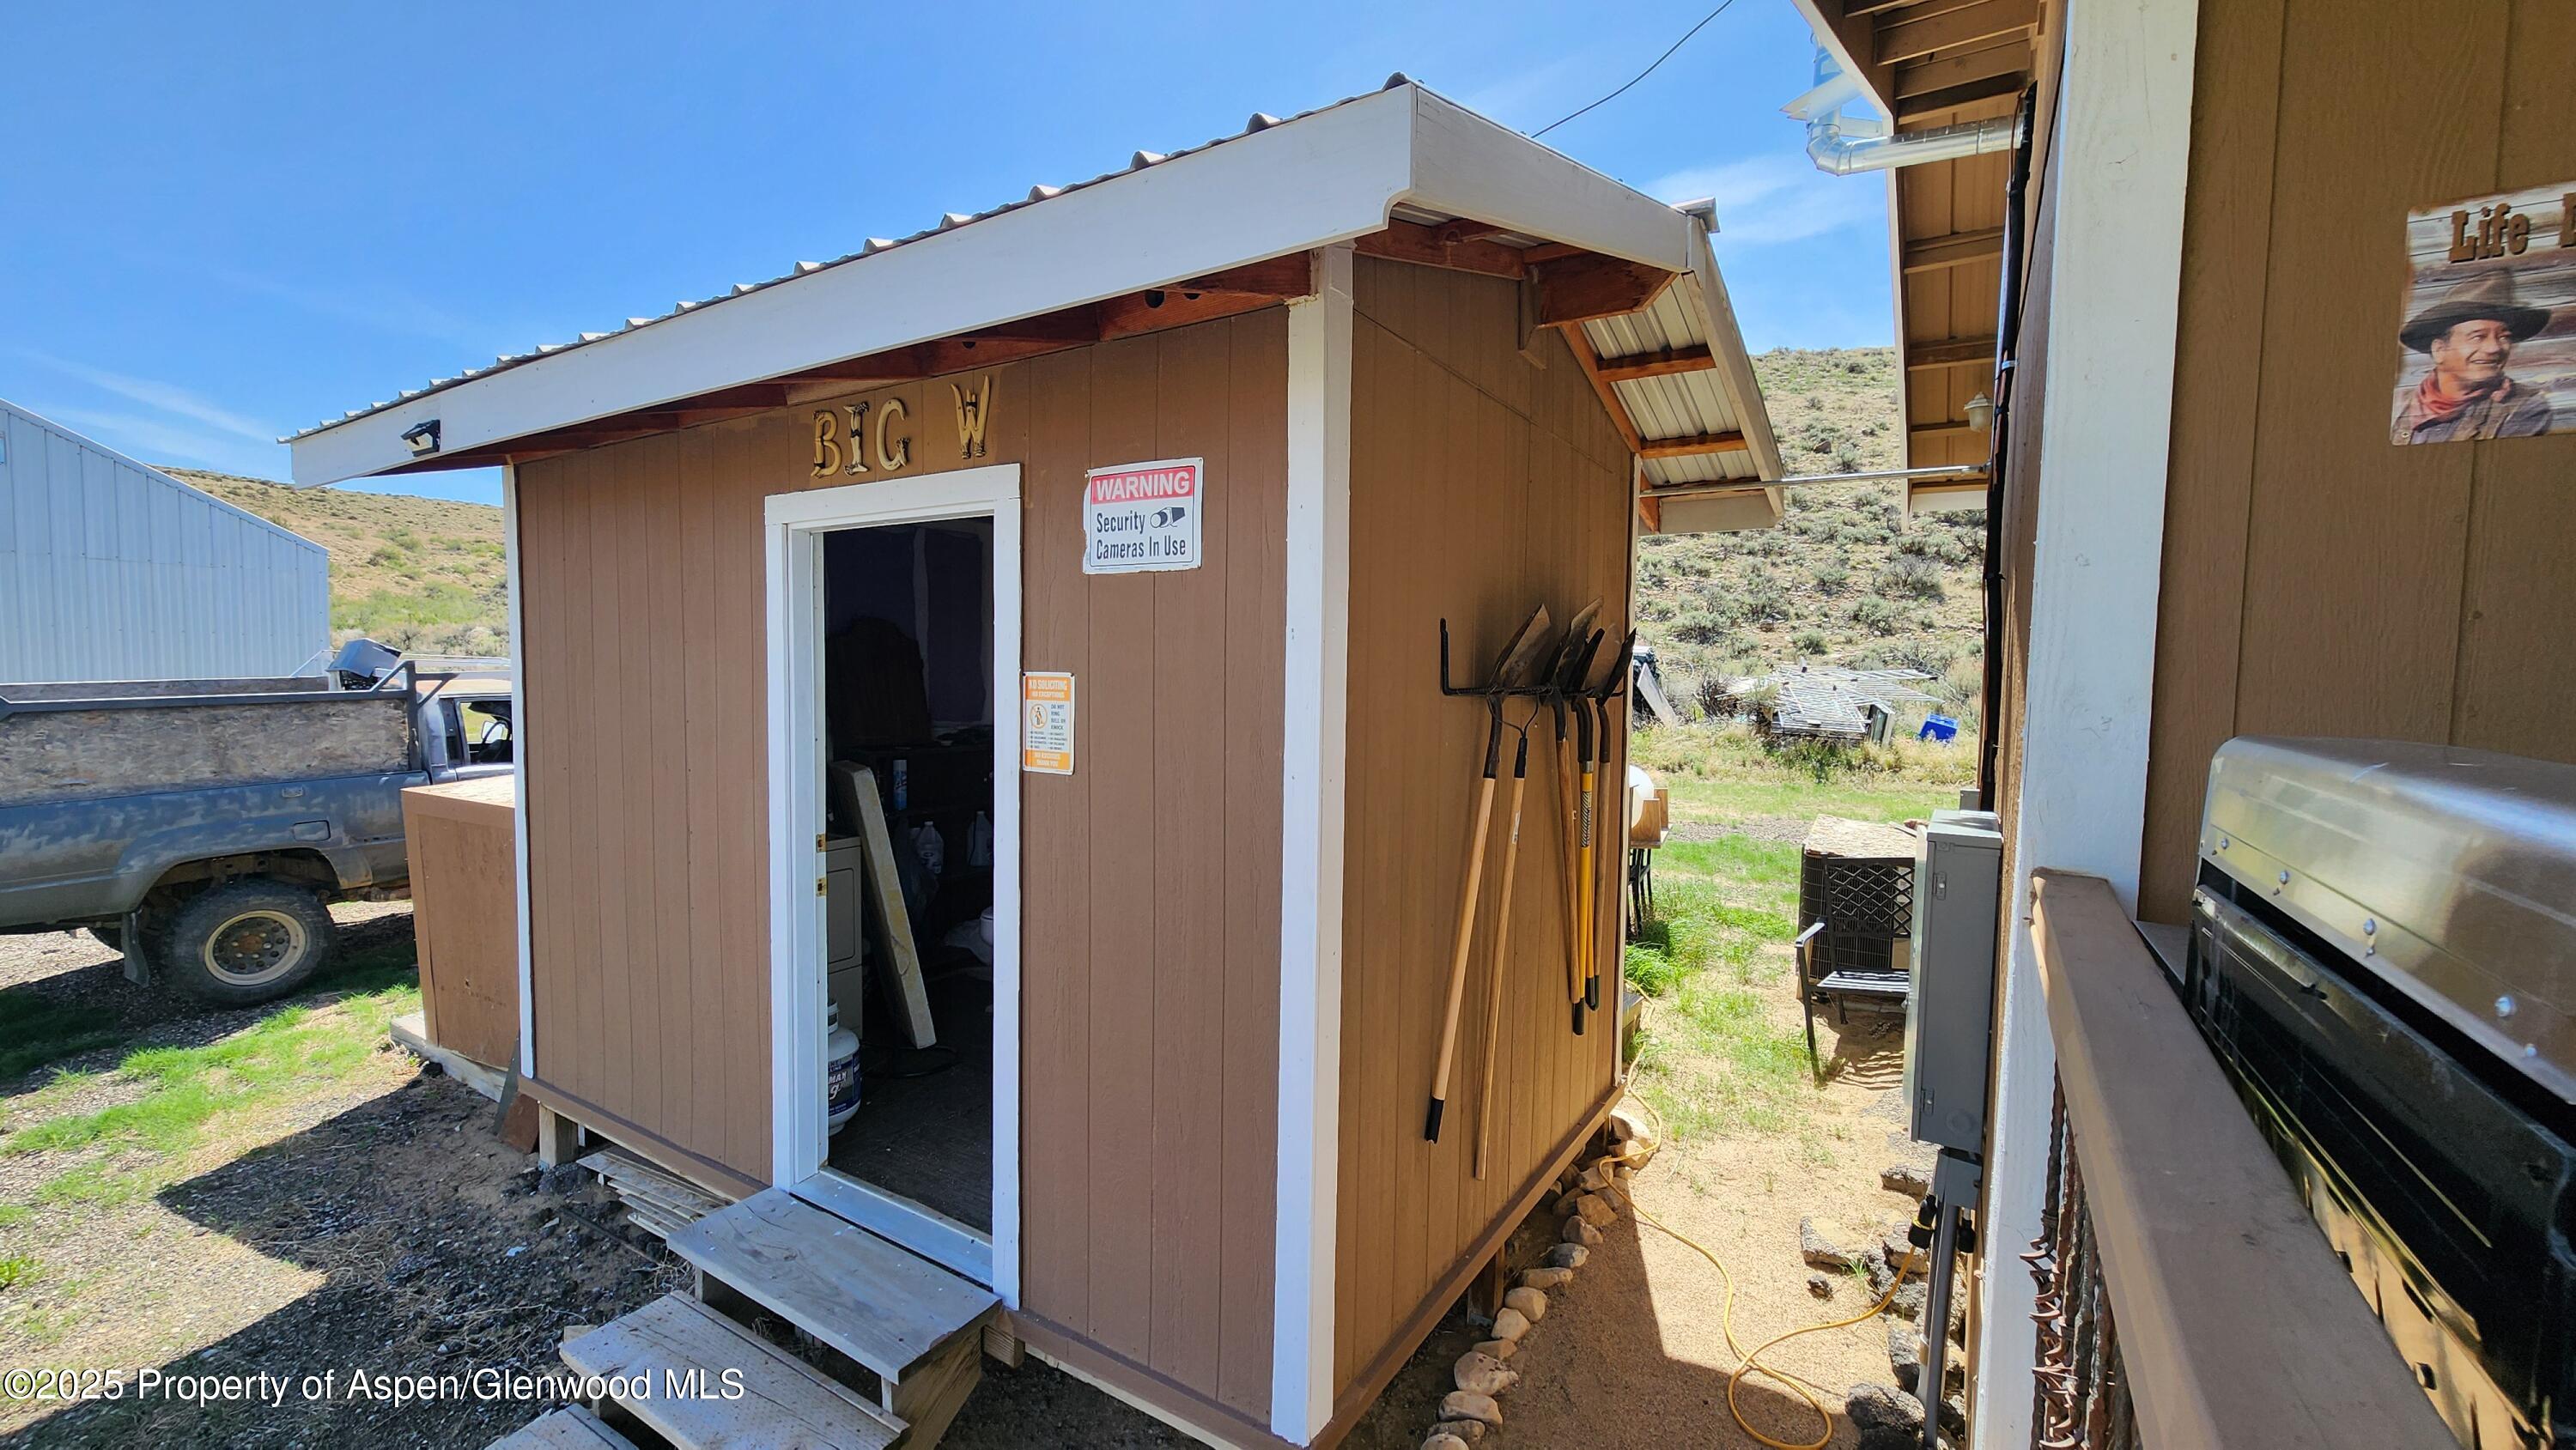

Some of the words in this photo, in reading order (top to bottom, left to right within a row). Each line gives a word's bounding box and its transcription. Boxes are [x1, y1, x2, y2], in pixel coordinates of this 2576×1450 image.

[2447, 203, 2530, 264] Life
[811, 398, 910, 478] BIG
[951, 374, 990, 459] W
[1096, 471, 1190, 501] WARNING
[1097, 510, 1145, 534] Security
[1097, 539, 1145, 560] Cameras
[1149, 536, 1159, 556] In
[1164, 535, 1186, 555] Use
